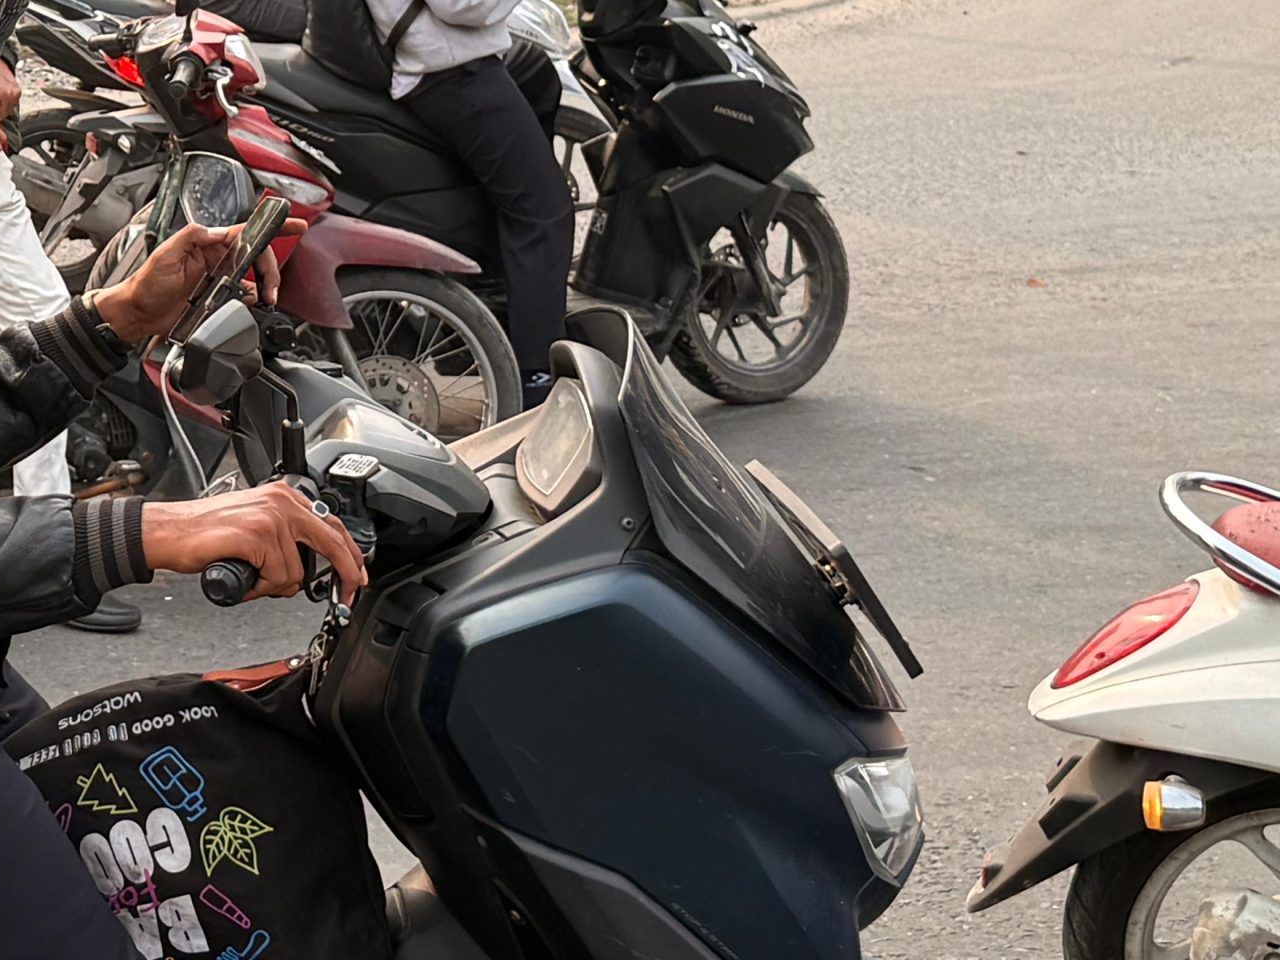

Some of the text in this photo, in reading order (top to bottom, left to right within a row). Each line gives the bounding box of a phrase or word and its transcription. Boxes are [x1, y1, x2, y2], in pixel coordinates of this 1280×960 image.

[713, 104, 755, 125] HONDA
[58, 690, 141, 730] watsons
[179, 705, 219, 724] LOOK
[132, 714, 176, 735] GOOD
[117, 894, 210, 960] BA
